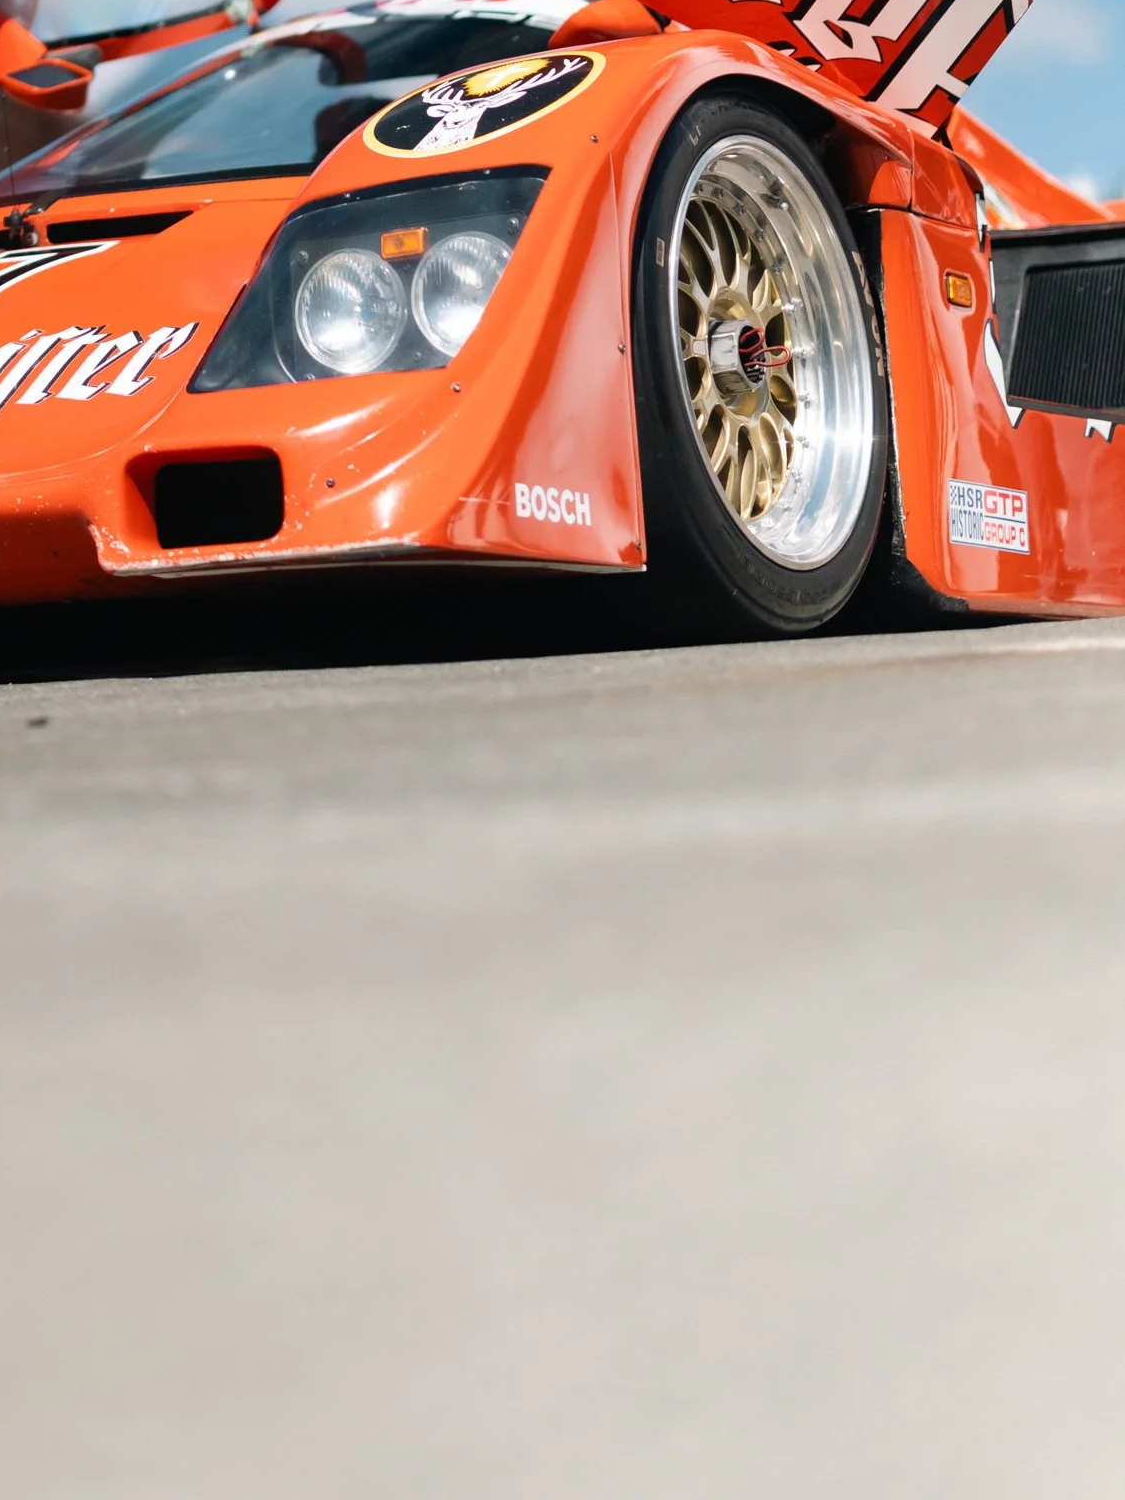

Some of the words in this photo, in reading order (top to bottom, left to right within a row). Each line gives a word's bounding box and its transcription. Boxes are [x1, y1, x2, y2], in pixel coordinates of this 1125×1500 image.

[515, 483, 591, 526] BOSCH
[958, 486, 983, 509] HSR
[984, 489, 1024, 517] GTP
[951, 507, 984, 541] HISTORIC
[984, 521, 1017, 545] GROUP
[1019, 526, 1026, 547] C
